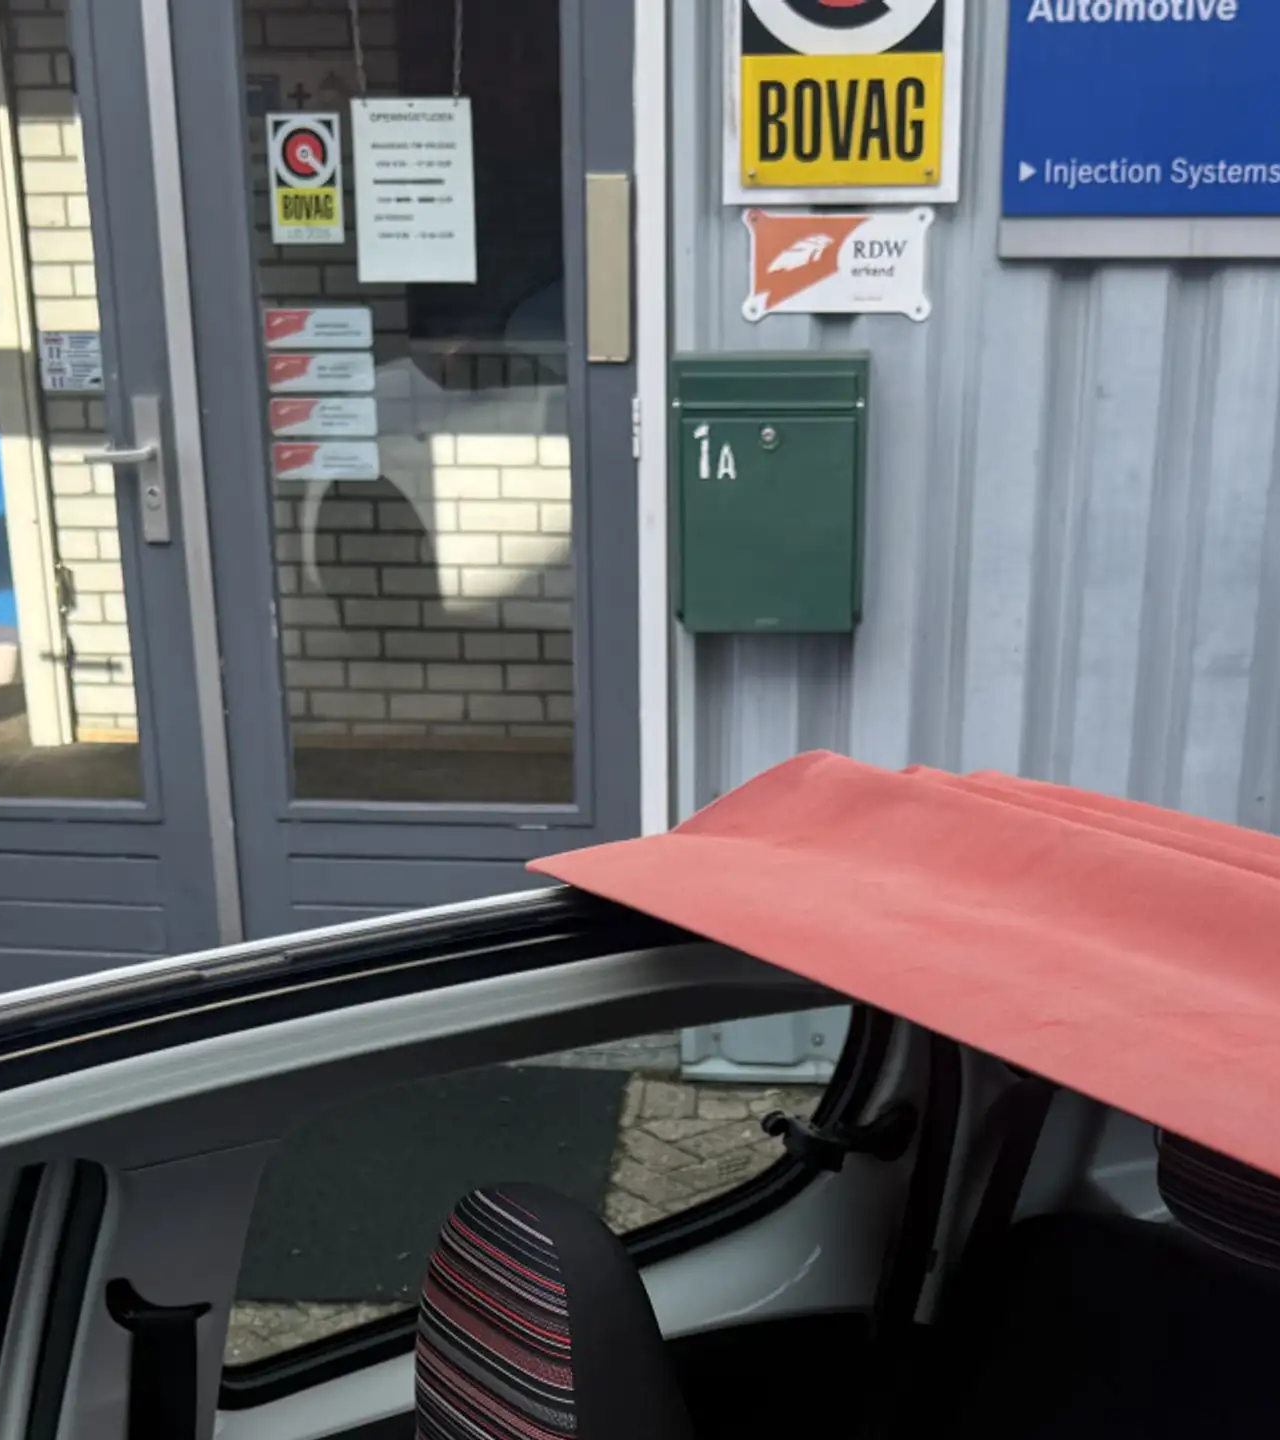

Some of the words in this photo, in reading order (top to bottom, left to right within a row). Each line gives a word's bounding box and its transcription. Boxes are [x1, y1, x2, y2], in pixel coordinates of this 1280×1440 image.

[1026, 0, 1239, 23] Automotive
[758, 77, 926, 163] BOVAG
[1044, 157, 1162, 189] Injection
[282, 194, 334, 221] BOVAG
[853, 239, 908, 259] RDW
[851, 264, 895, 277] erkend
[694, 423, 737, 480] 1A
